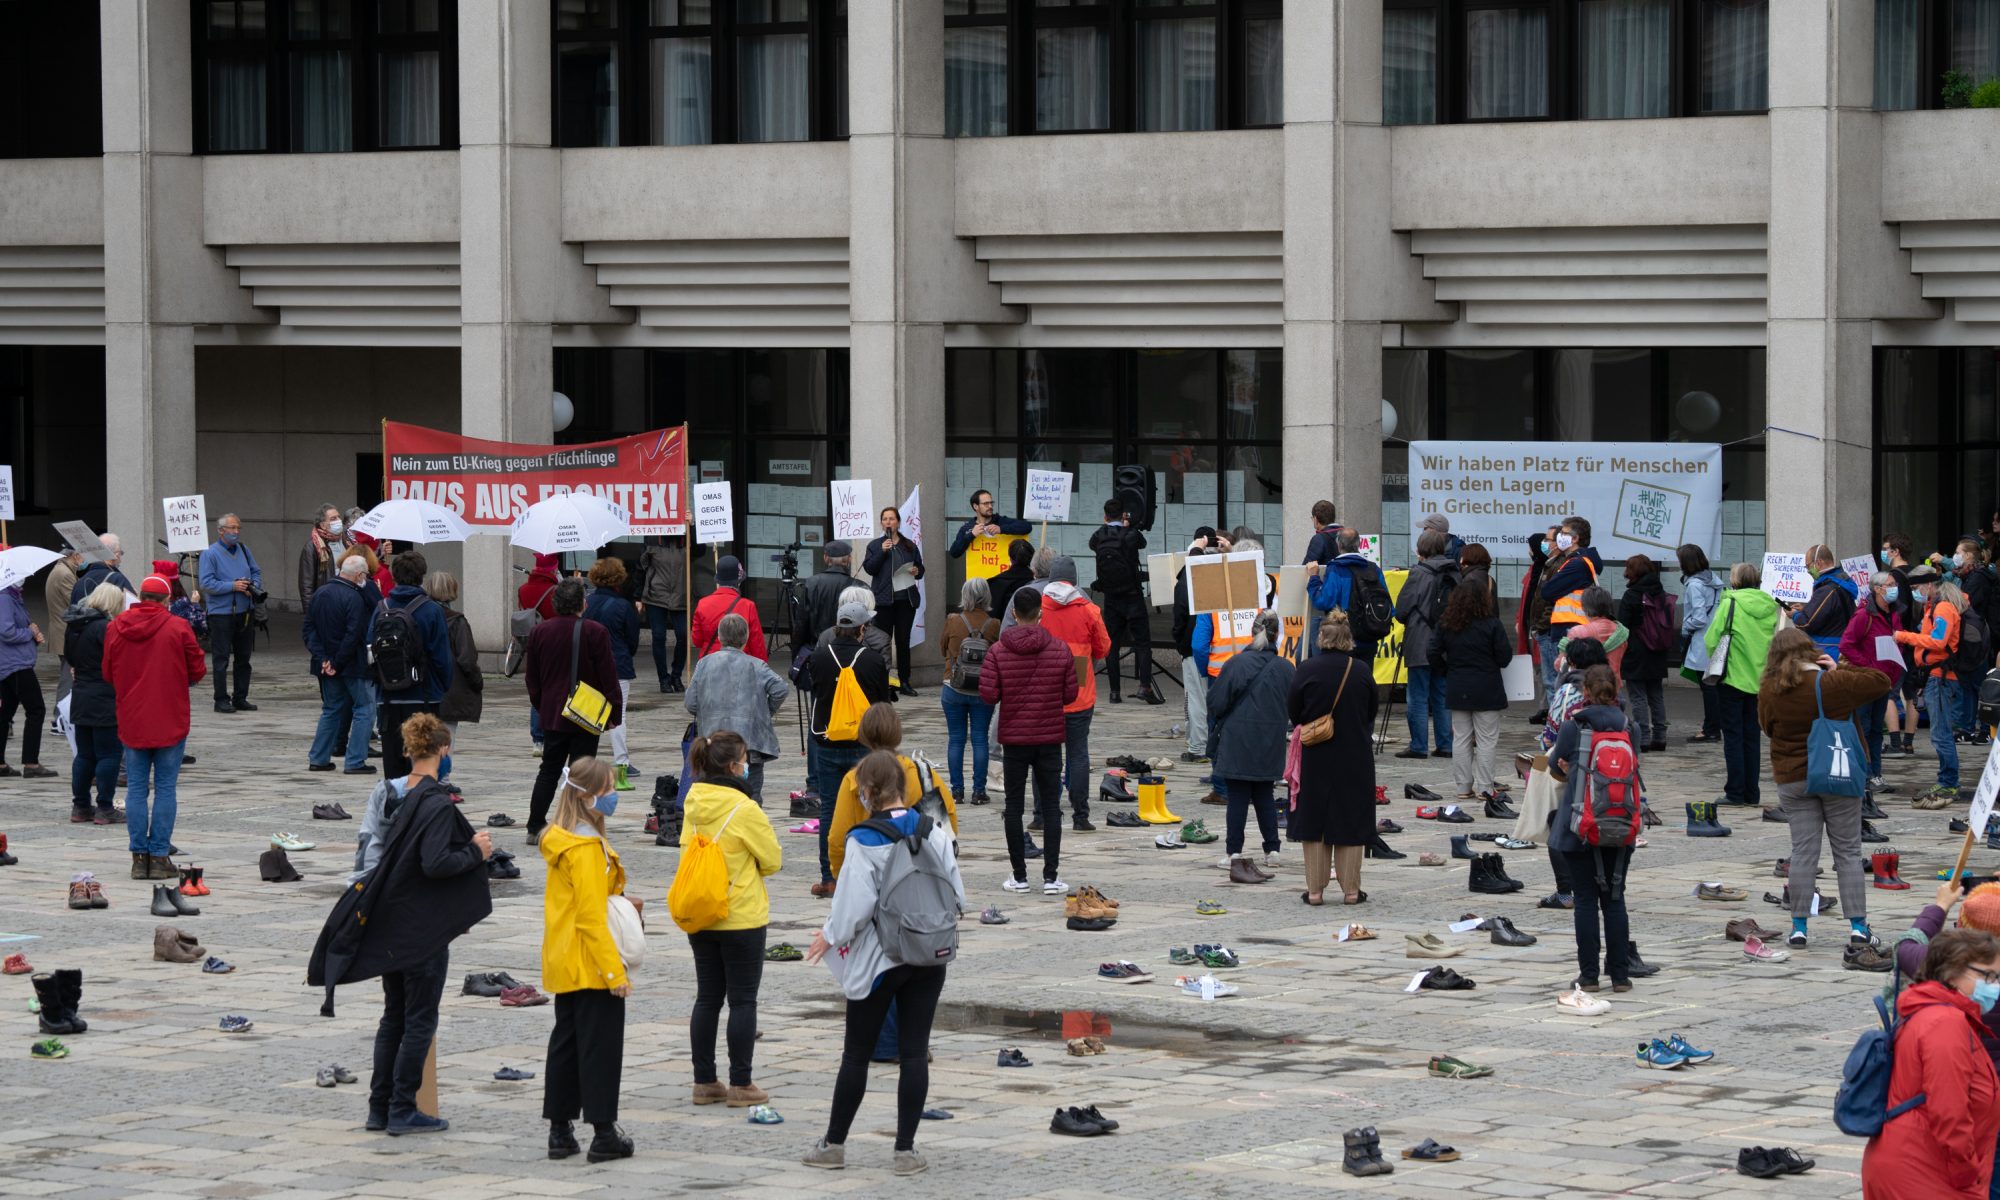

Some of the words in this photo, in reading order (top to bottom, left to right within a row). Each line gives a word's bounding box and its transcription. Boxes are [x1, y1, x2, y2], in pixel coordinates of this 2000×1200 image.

[393, 457, 421, 471] Nein
[425, 460, 450, 471] zum
[453, 456, 502, 472] EU-Krieg
[505, 456, 543, 472] gegen
[547, 448, 616, 467] Flüchtlinge
[1421, 455, 1452, 470] Wir
[1459, 455, 1516, 471] haben
[1523, 456, 1569, 472] Platz
[1576, 456, 1604, 472] für
[1610, 457, 1708, 473] Menschen
[771, 463, 809, 471] AMTSTAFEL
[1421, 479, 1453, 491] aus
[1459, 476, 1493, 491] den
[1500, 477, 1565, 495] Lagern
[475, 483, 528, 520] AUS
[539, 483, 678, 519] FNTEX!
[702, 493, 722, 501] OMAS
[837, 486, 857, 507] Wir
[701, 505, 725, 513] GEGEN
[1421, 498, 1437, 513] in
[1444, 498, 1575, 515] Griechenland!
[168, 513, 199, 524] HABEN
[834, 510, 868, 520] haben
[1630, 503, 1671, 525] HABEN
[700, 518, 727, 526] RECHTS
[171, 526, 201, 536] PLATZ
[838, 521, 872, 538] Platz
[1633, 518, 1663, 539] PLATZ
[1456, 534, 1498, 543] lattform
[1501, 535, 1529, 543] Solida
[970, 539, 997, 551] Linz
[981, 554, 999, 566] hat
[1776, 580, 1801, 591] ALLE
[1771, 589, 1808, 599] MENSCHEN
[1221, 611, 1255, 621] ODNER
